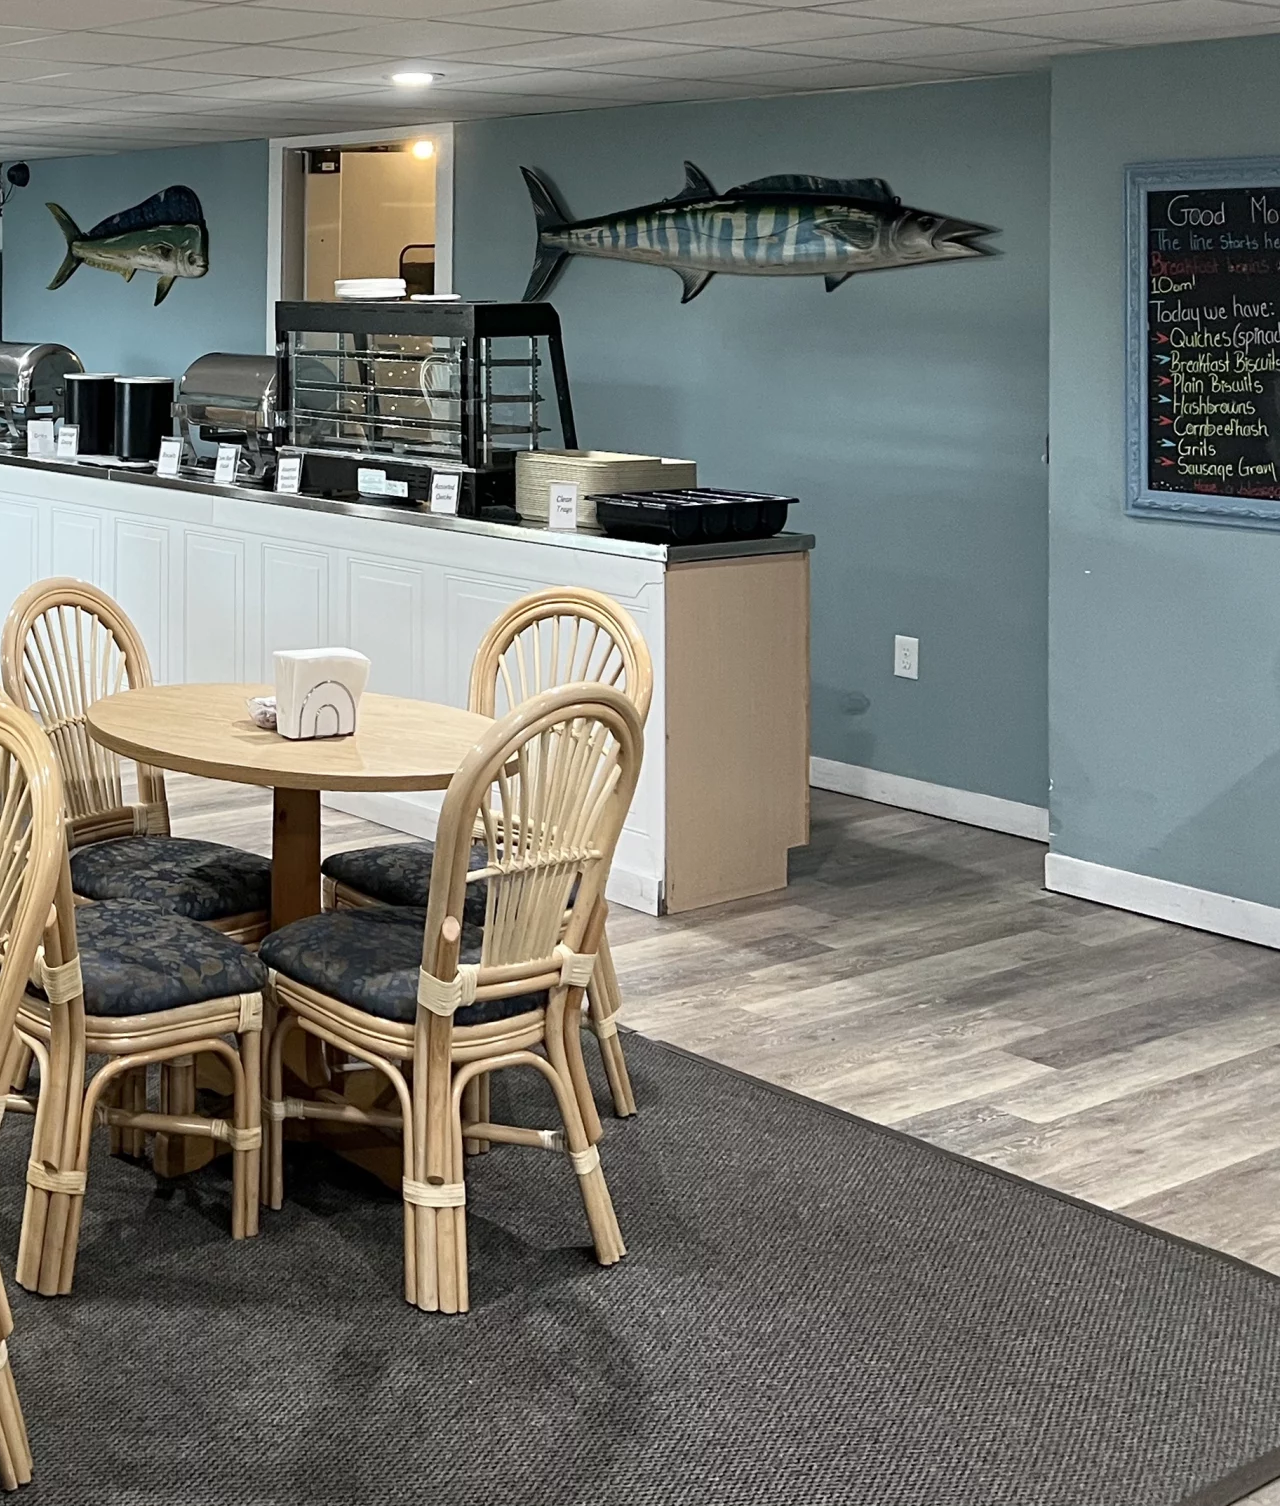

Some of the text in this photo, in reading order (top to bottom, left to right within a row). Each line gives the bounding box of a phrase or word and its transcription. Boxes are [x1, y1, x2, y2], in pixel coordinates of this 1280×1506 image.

[1167, 194, 1225, 226] Good
[1150, 228, 1182, 251] The
[1190, 230, 1214, 251] line
[1150, 251, 1219, 276] Breakfast
[1150, 273, 1196, 294] 10am!
[1149, 294, 1275, 332] Today we have:
[1170, 321, 1280, 355] Quiches (spinac
[1169, 348, 1280, 373] Breakfast Biscuits
[1170, 372, 1264, 394] Plain Biscuits
[1173, 394, 1256, 415] Hashbrowns
[1173, 415, 1270, 437] Cornbeefhash
[1177, 438, 1217, 457] Grits
[1177, 456, 1278, 482] Sausage Gravy
